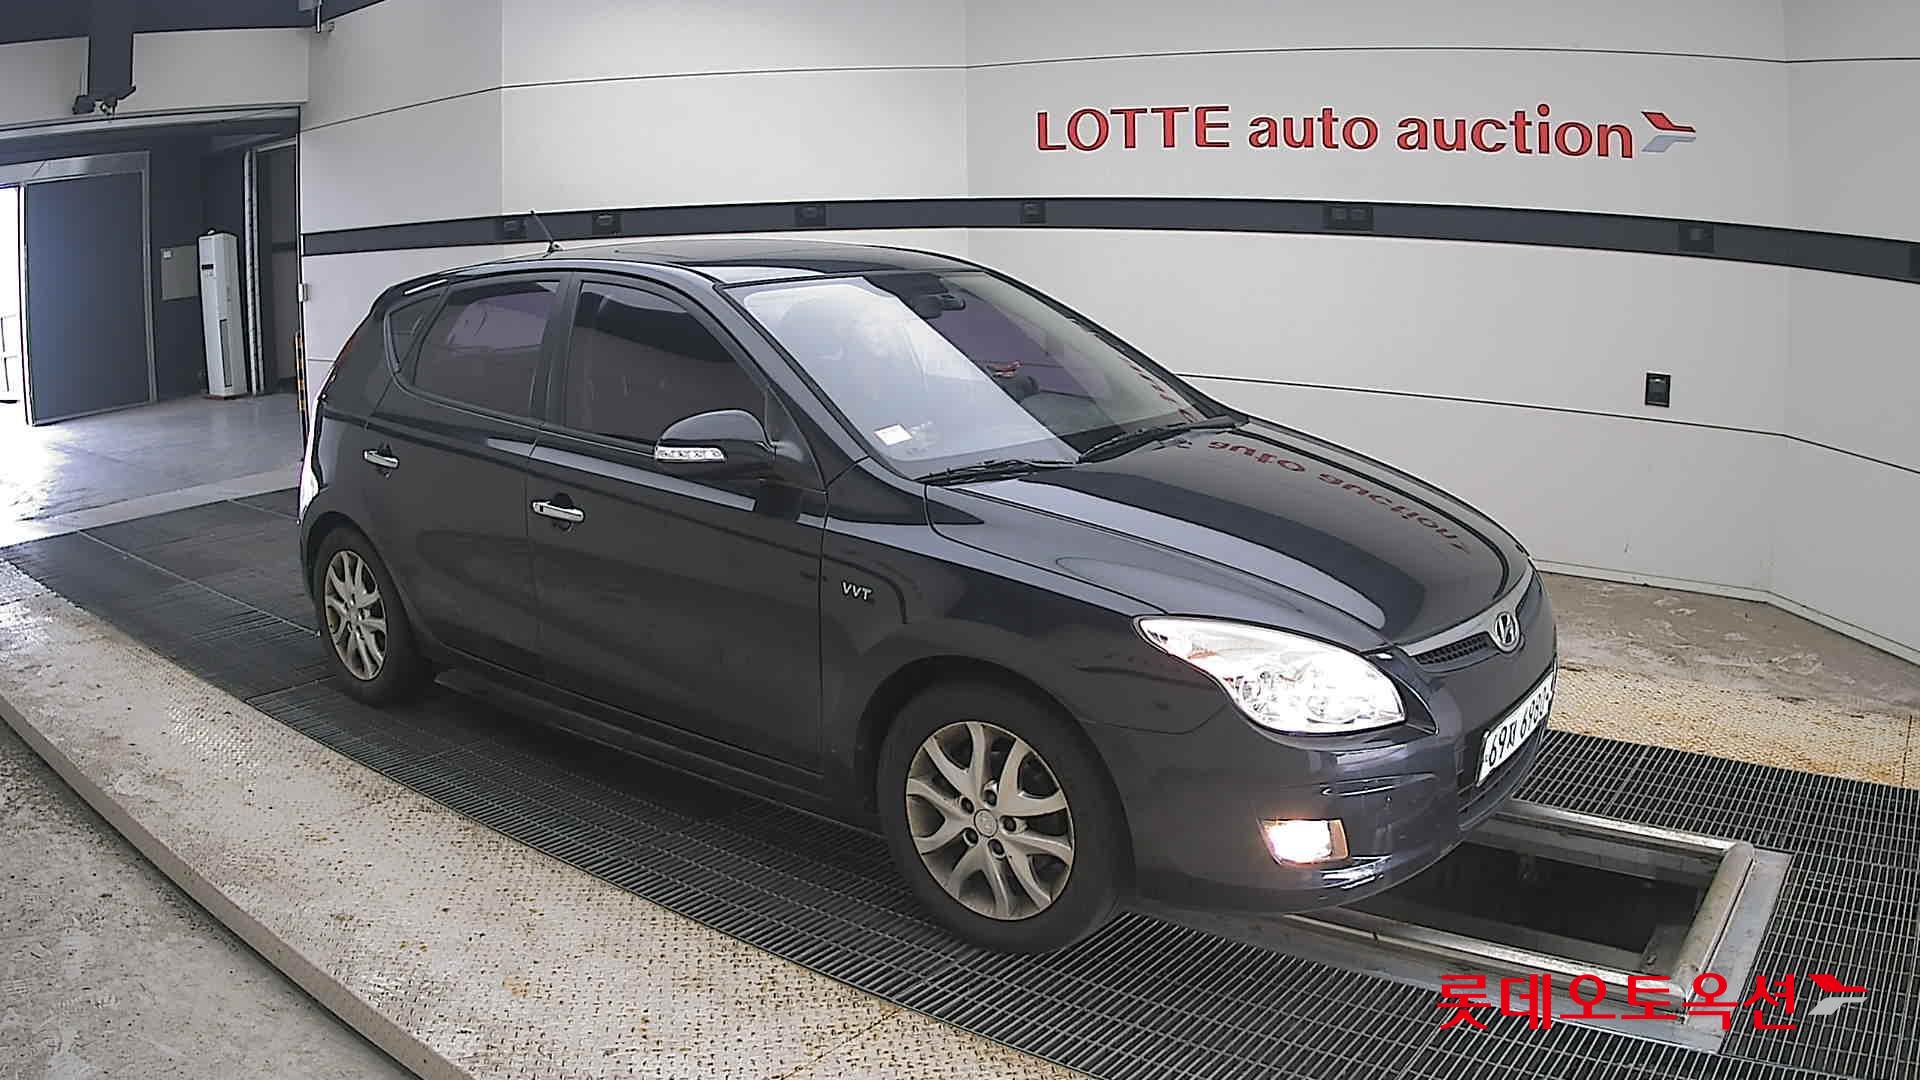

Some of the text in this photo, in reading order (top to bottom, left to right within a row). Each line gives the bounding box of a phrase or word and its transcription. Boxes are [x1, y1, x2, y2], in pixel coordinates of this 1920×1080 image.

[1037, 104, 1633, 158] LOTTE auto auction
[841, 580, 872, 601] VVT
